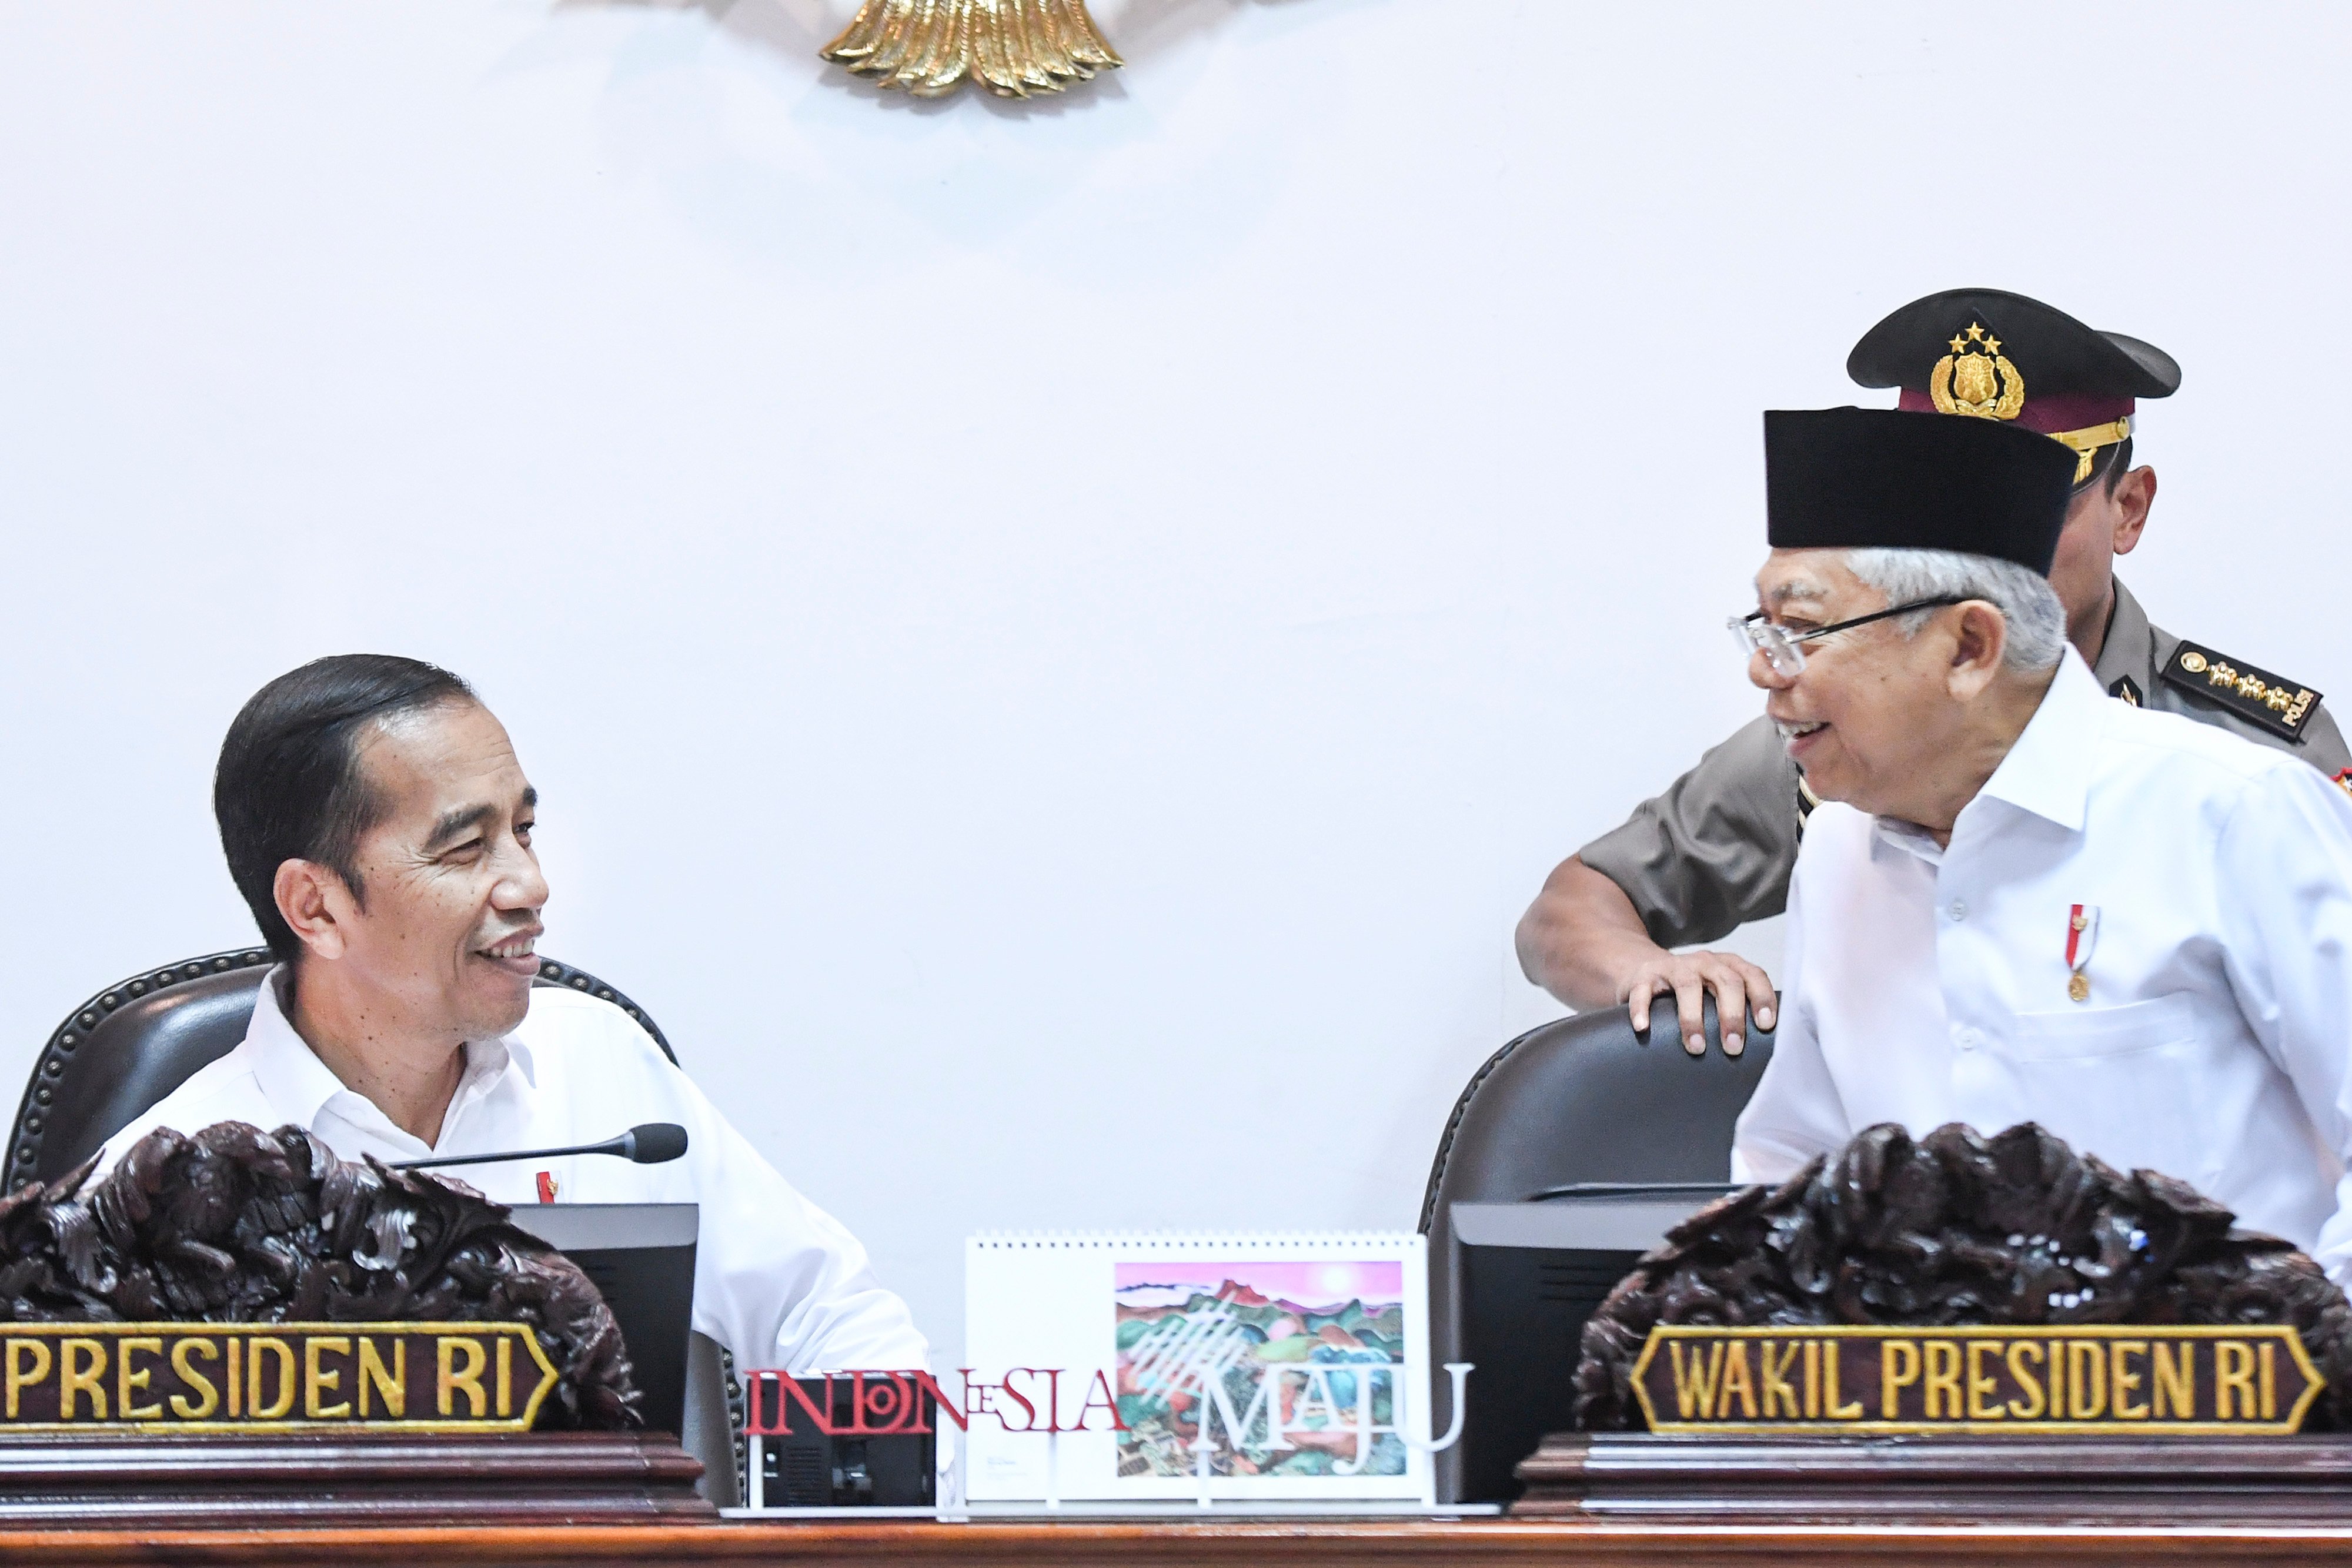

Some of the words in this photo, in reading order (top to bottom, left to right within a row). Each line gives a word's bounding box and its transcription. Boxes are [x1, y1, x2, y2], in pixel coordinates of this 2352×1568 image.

[5, 1338, 406, 1419] PRESIDEN
[437, 1337, 511, 1417] RI
[743, 1368, 1132, 1436] INDONESIA
[1188, 1362, 1475, 1475] MAJU
[1669, 1340, 1863, 1418] WAKIL
[1883, 1340, 2194, 1419] PRESIDEN
[2214, 1342, 2276, 1420] RI
